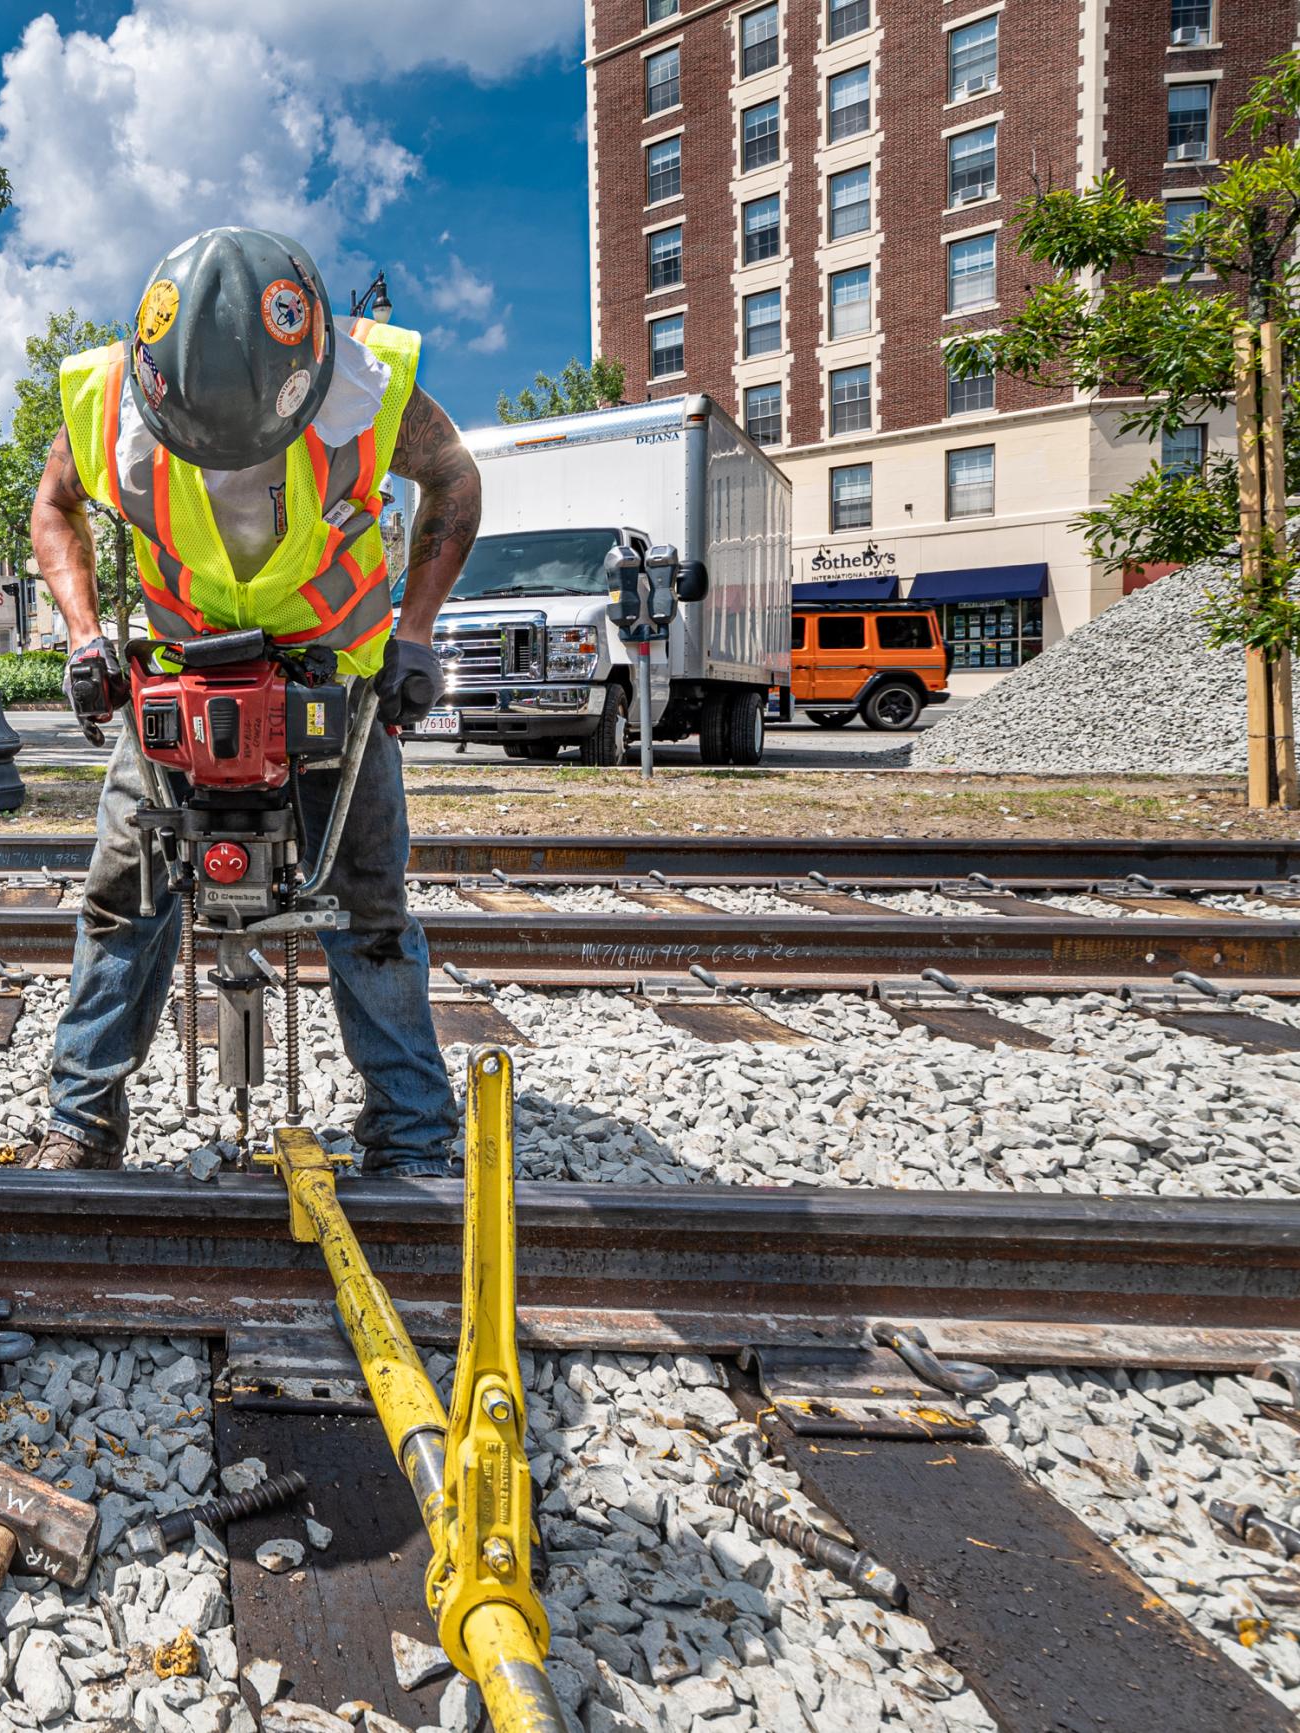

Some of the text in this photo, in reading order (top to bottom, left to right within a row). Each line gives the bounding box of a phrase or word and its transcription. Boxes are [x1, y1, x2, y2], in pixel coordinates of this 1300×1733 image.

[636, 432, 679, 445] DEJANA
[811, 552, 896, 570] Sotheby's
[811, 573, 867, 582] INTERNATIONAL
[440, 717, 457, 729] 106
[220, 846, 228, 855] N
